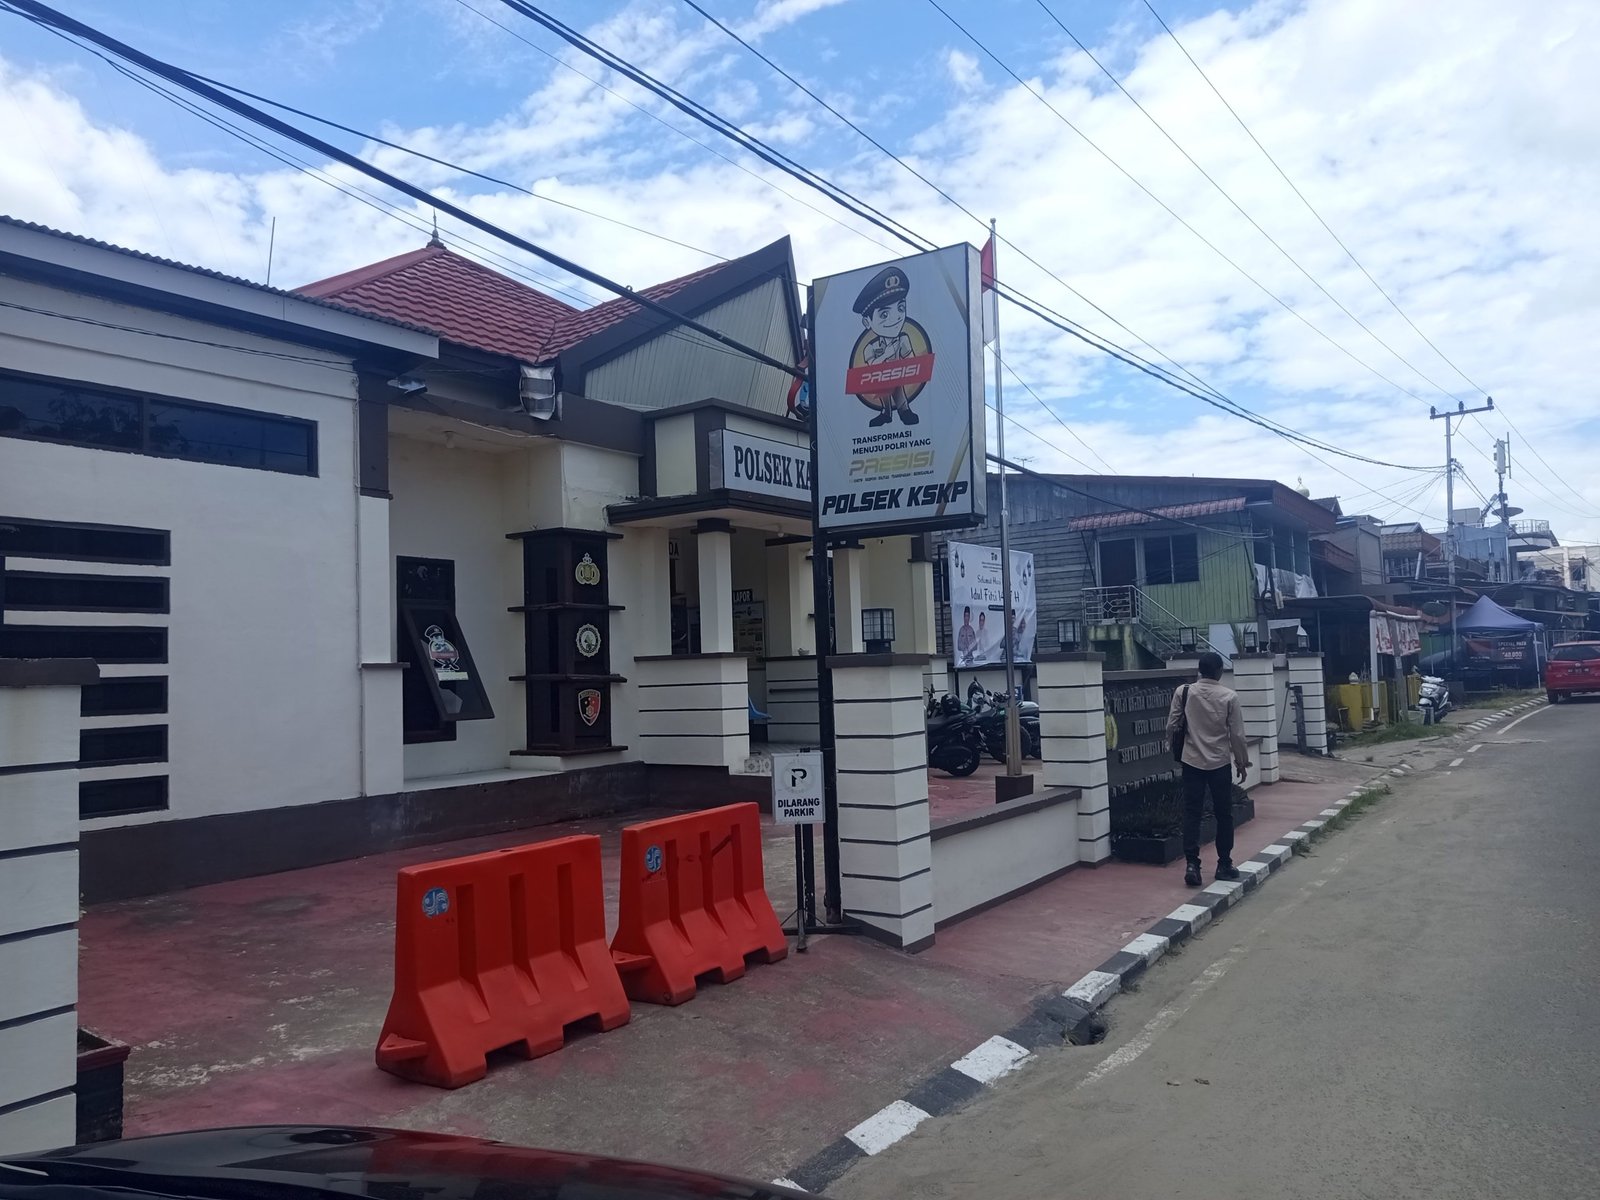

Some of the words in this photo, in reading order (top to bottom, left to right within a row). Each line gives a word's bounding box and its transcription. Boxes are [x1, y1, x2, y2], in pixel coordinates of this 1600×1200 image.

[860, 363, 921, 385] PRESISI
[852, 430, 912, 445] TRANSFORMASI
[852, 444, 884, 455] MENUJU
[885, 440, 908, 451] POLRI
[909, 438, 932, 448] YANG
[733, 445, 793, 488] POLSEK
[848, 450, 935, 477] PRESISI
[821, 488, 904, 516] POLSEK
[906, 480, 969, 508] KSKP
[777, 798, 820, 808] DILARANG
[784, 808, 815, 817] PARKIR
